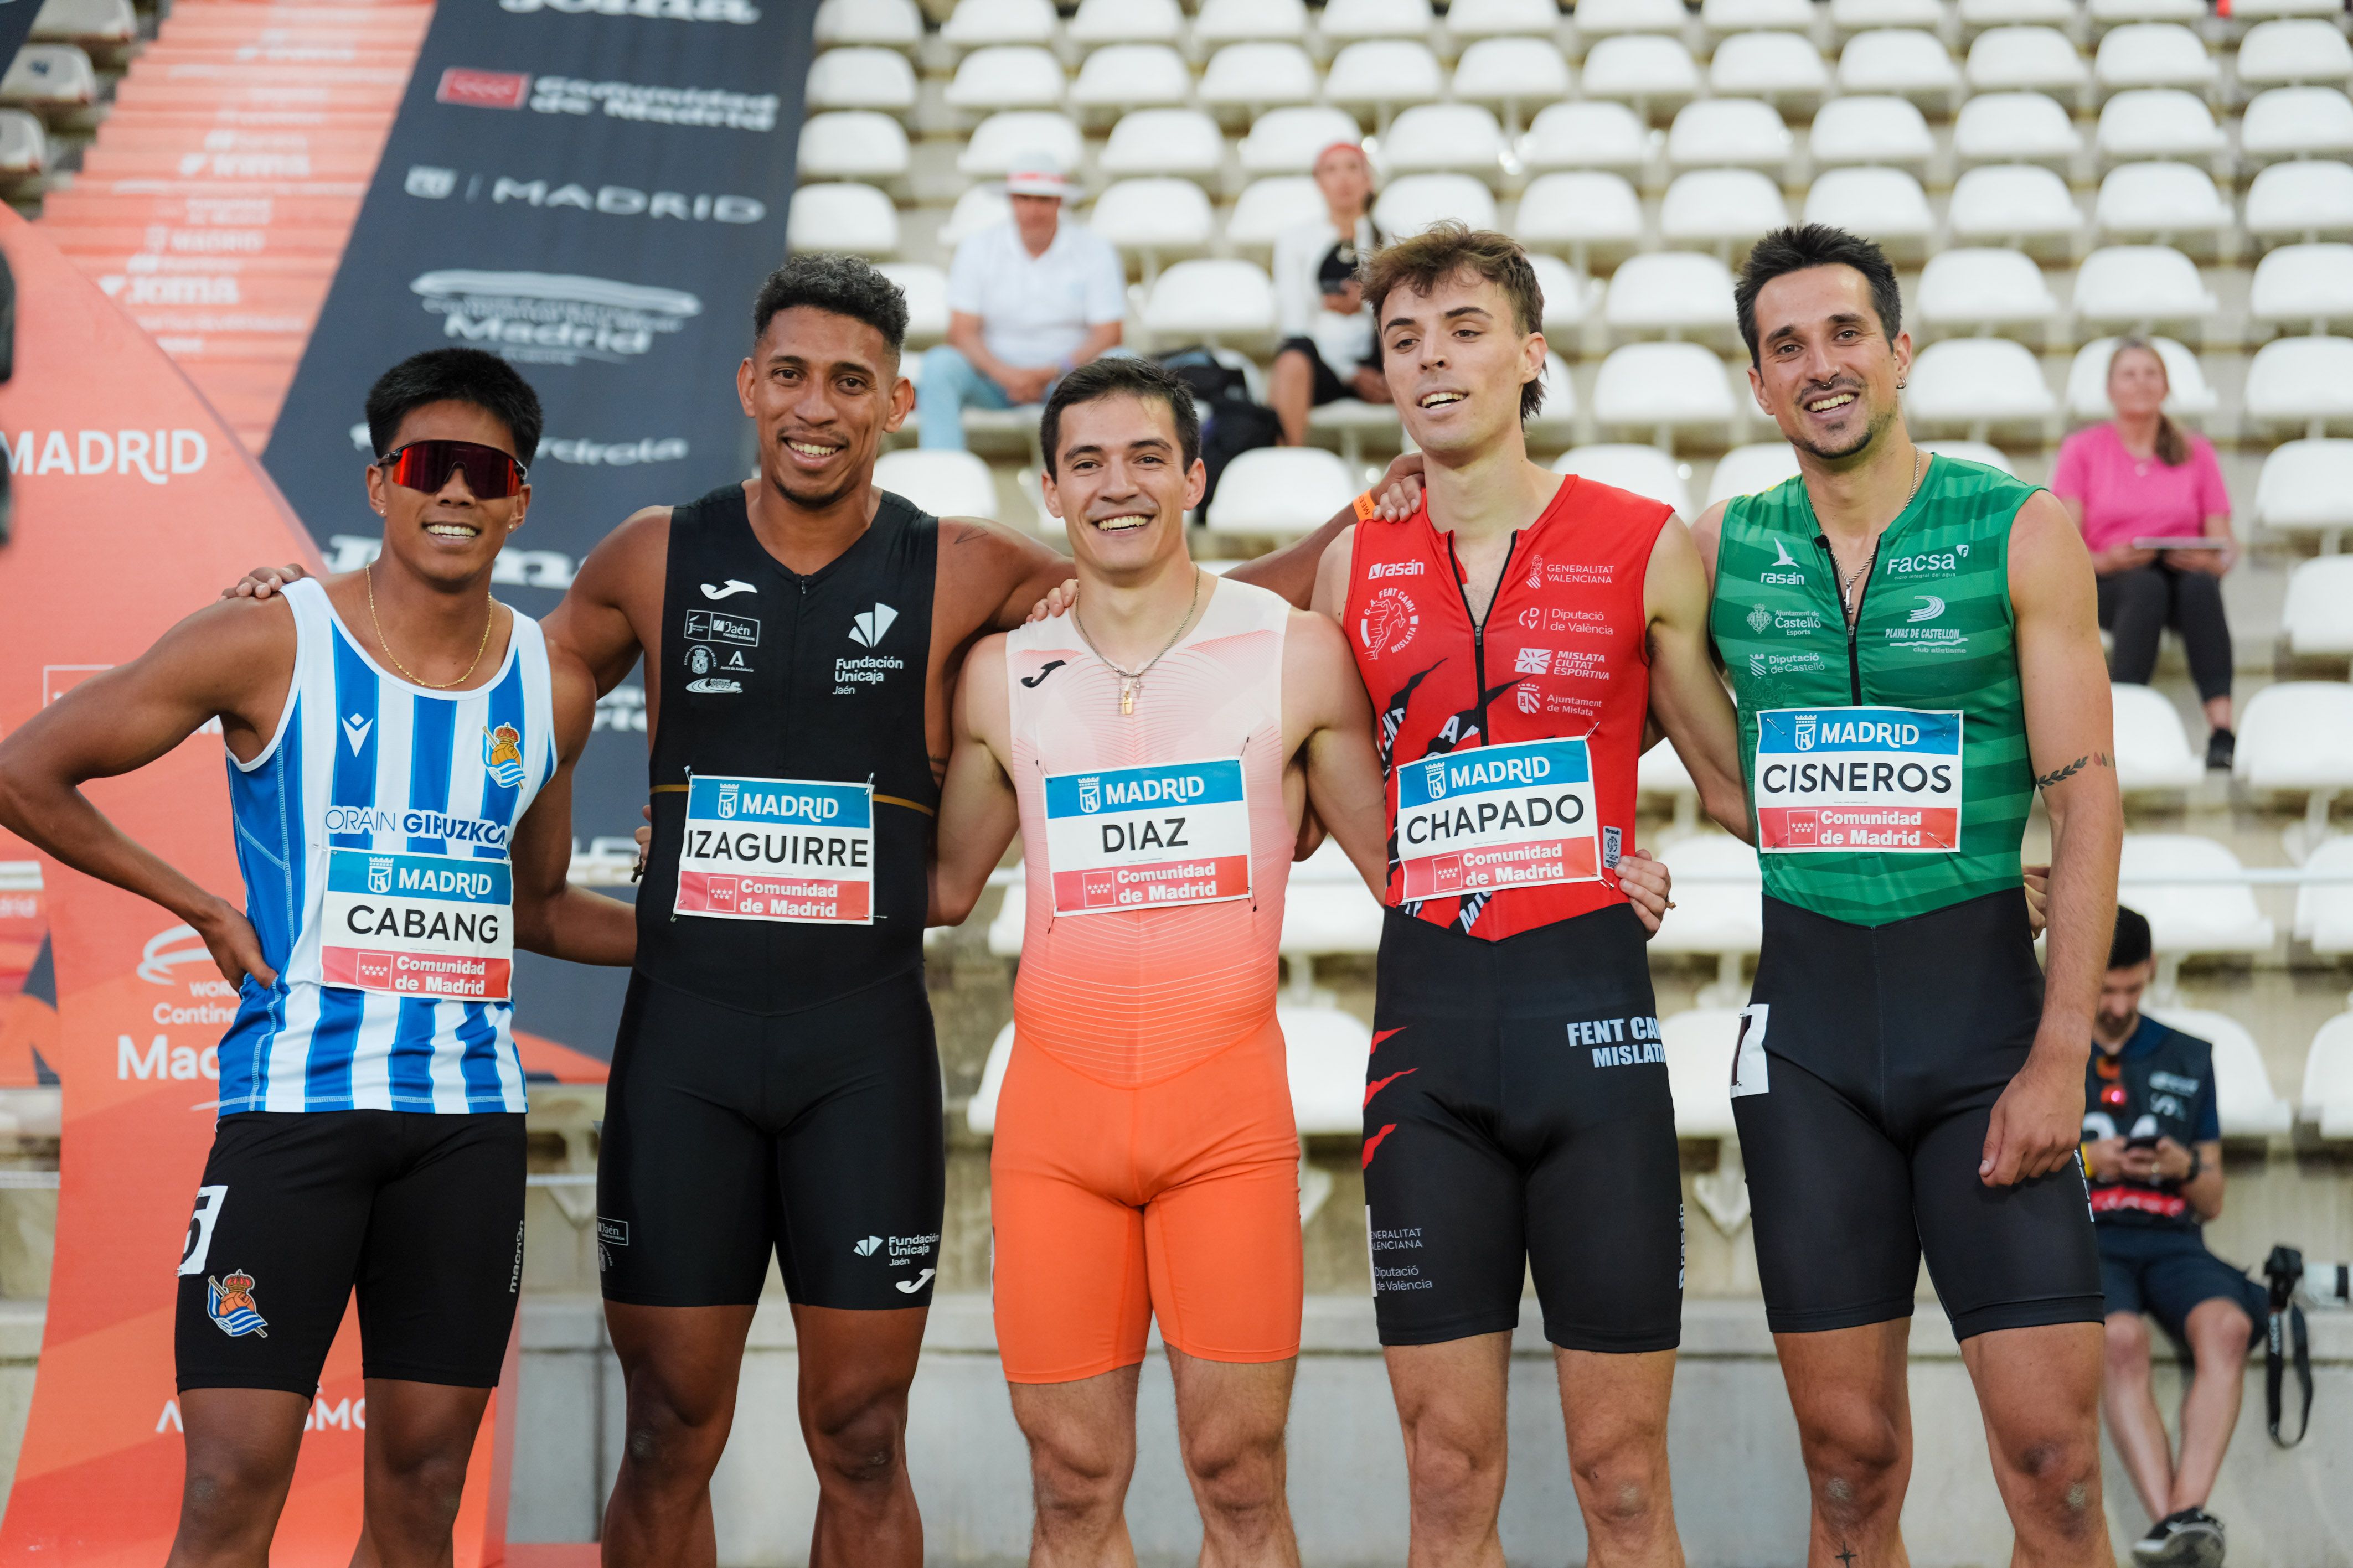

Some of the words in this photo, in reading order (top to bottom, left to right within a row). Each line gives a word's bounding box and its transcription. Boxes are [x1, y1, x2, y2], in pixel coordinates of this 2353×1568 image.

[534, 76, 778, 111] Comunidad
[530, 94, 594, 115] de
[604, 99, 775, 132] Madrid
[492, 177, 766, 223] MADRID
[445, 312, 653, 355] Madrid
[0, 429, 207, 484] MADRID
[1380, 559, 1424, 577] rasán
[1547, 564, 1614, 573] GENERALITAT
[1547, 574, 1612, 583] VALENCIANA
[1760, 572, 1805, 585] rasán
[1379, 588, 1398, 599] FENT
[1397, 591, 1416, 613] CAMI
[1552, 608, 1604, 620] Diputació
[1774, 617, 1821, 628] Castelló
[725, 620, 751, 636] Jaén
[1550, 622, 1565, 631] de
[1568, 622, 1613, 635] València
[1885, 628, 1910, 639] PLAYAS
[1910, 628, 1920, 639] DE
[1921, 628, 1960, 639] CASTELLON
[1390, 627, 1417, 654] MISLATA
[835, 655, 904, 670] Fundación
[1555, 659, 1594, 670] CIUTAT
[1557, 651, 1605, 663] MISLATA
[1769, 653, 1820, 665] Diputació
[1553, 667, 1609, 680] ESPORTIVA
[1771, 665, 1783, 674] de
[1784, 661, 1825, 672] Castelló
[834, 669, 885, 685] Unicaja
[832, 685, 855, 695] Jaén
[1547, 694, 1602, 707] Ajuntament
[1547, 704, 1560, 712] de
[1562, 705, 1593, 716] Mislata
[1821, 721, 1919, 748] MADRID
[1450, 756, 1550, 789] MADRID
[1763, 762, 1952, 794] CISNEROS
[1105, 776, 1205, 805] MADRID
[742, 793, 839, 823] MADRID
[325, 809, 396, 832] ORAIN
[1406, 794, 1584, 845] CHAPADO
[1820, 810, 1922, 826] Comunidad
[1101, 817, 1188, 853] DIAZ
[1820, 829, 1845, 845] de
[1850, 829, 1921, 846] Madrid
[685, 830, 868, 867] IZAGUIRRE
[1462, 843, 1563, 867] Comunidad
[1117, 862, 1216, 884] Comunidad
[1465, 871, 1489, 887] de
[1495, 862, 1564, 883] Madrid
[398, 867, 492, 899] MADRID
[740, 879, 838, 898] Comunidad
[1118, 889, 1143, 904] de
[1148, 880, 1217, 901] Madrid
[740, 898, 764, 913] de
[770, 899, 837, 917] Madrid
[347, 905, 499, 944] CABANG
[396, 956, 486, 975] Comunidad
[189, 980, 239, 997] WOR
[395, 975, 419, 990] de
[425, 976, 485, 995] Madrid
[1566, 1018, 1624, 1047] FENT
[601, 1223, 619, 1236] Jaén
[1370, 1228, 1422, 1239] ENERALITAT
[889, 1233, 940, 1246] Fundación
[1371, 1239, 1423, 1250] ALENCIANA
[889, 1243, 930, 1256] Unicaja
[889, 1257, 910, 1266] Jaén
[1374, 1265, 1419, 1279] Diputació
[1376, 1281, 1385, 1291] de
[1385, 1279, 1432, 1291] València
